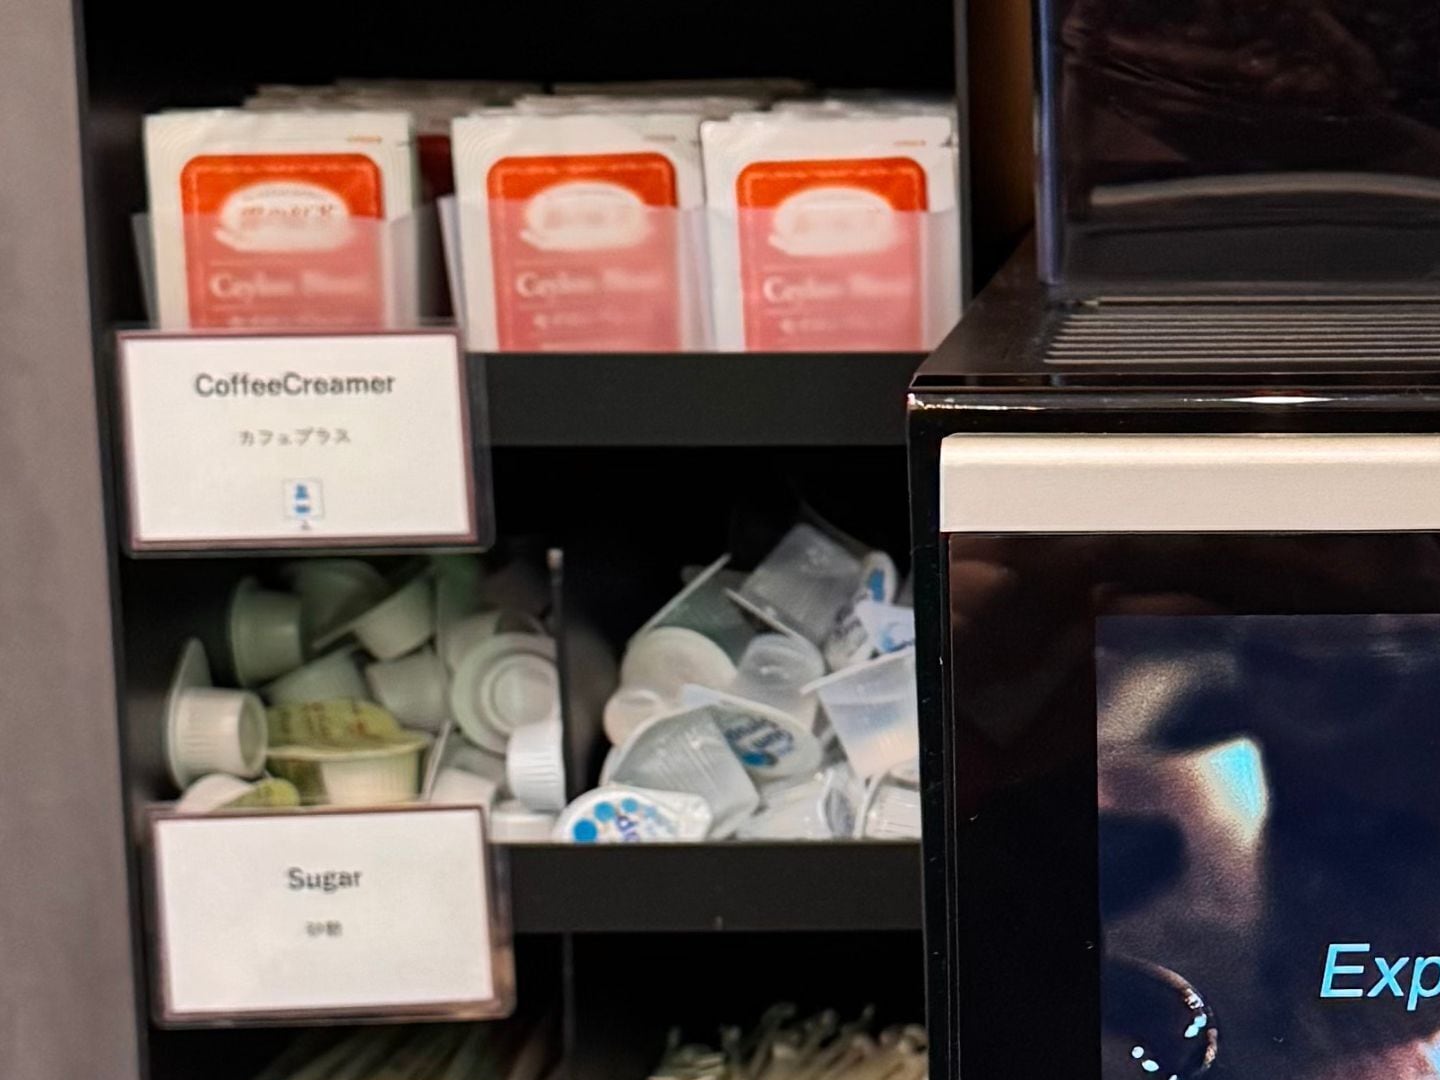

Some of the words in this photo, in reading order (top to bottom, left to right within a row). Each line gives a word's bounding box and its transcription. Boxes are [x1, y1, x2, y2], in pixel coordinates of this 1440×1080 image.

[194, 372, 395, 398] CoffeeCreamer
[239, 427, 351, 447] カフェプラス
[287, 867, 362, 892] Sugar
